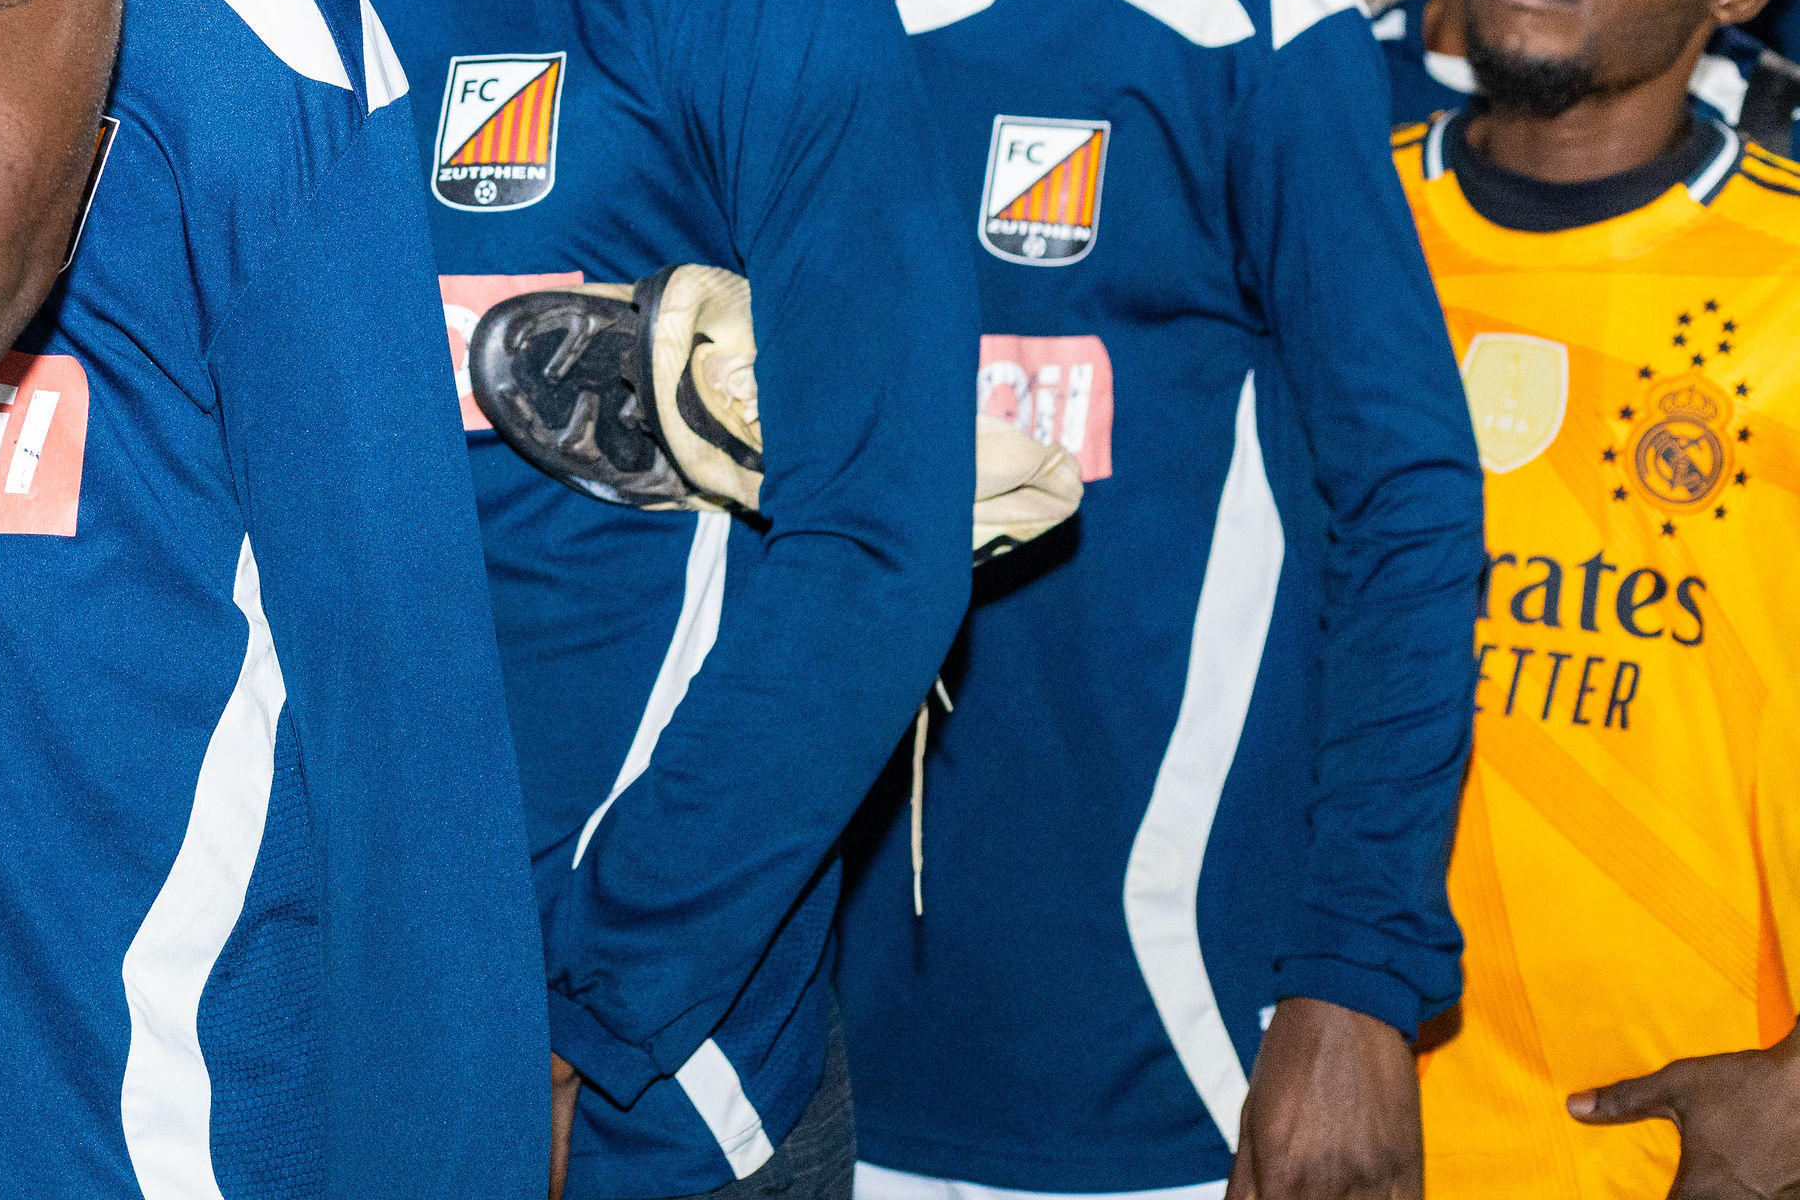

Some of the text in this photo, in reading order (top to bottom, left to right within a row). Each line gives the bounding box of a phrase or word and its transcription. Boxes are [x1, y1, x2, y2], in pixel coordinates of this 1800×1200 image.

[459, 77, 499, 104] FC
[1007, 139, 1046, 165] FC
[438, 165, 547, 182] ZUTPHEN
[977, 359, 1094, 454] Oil
